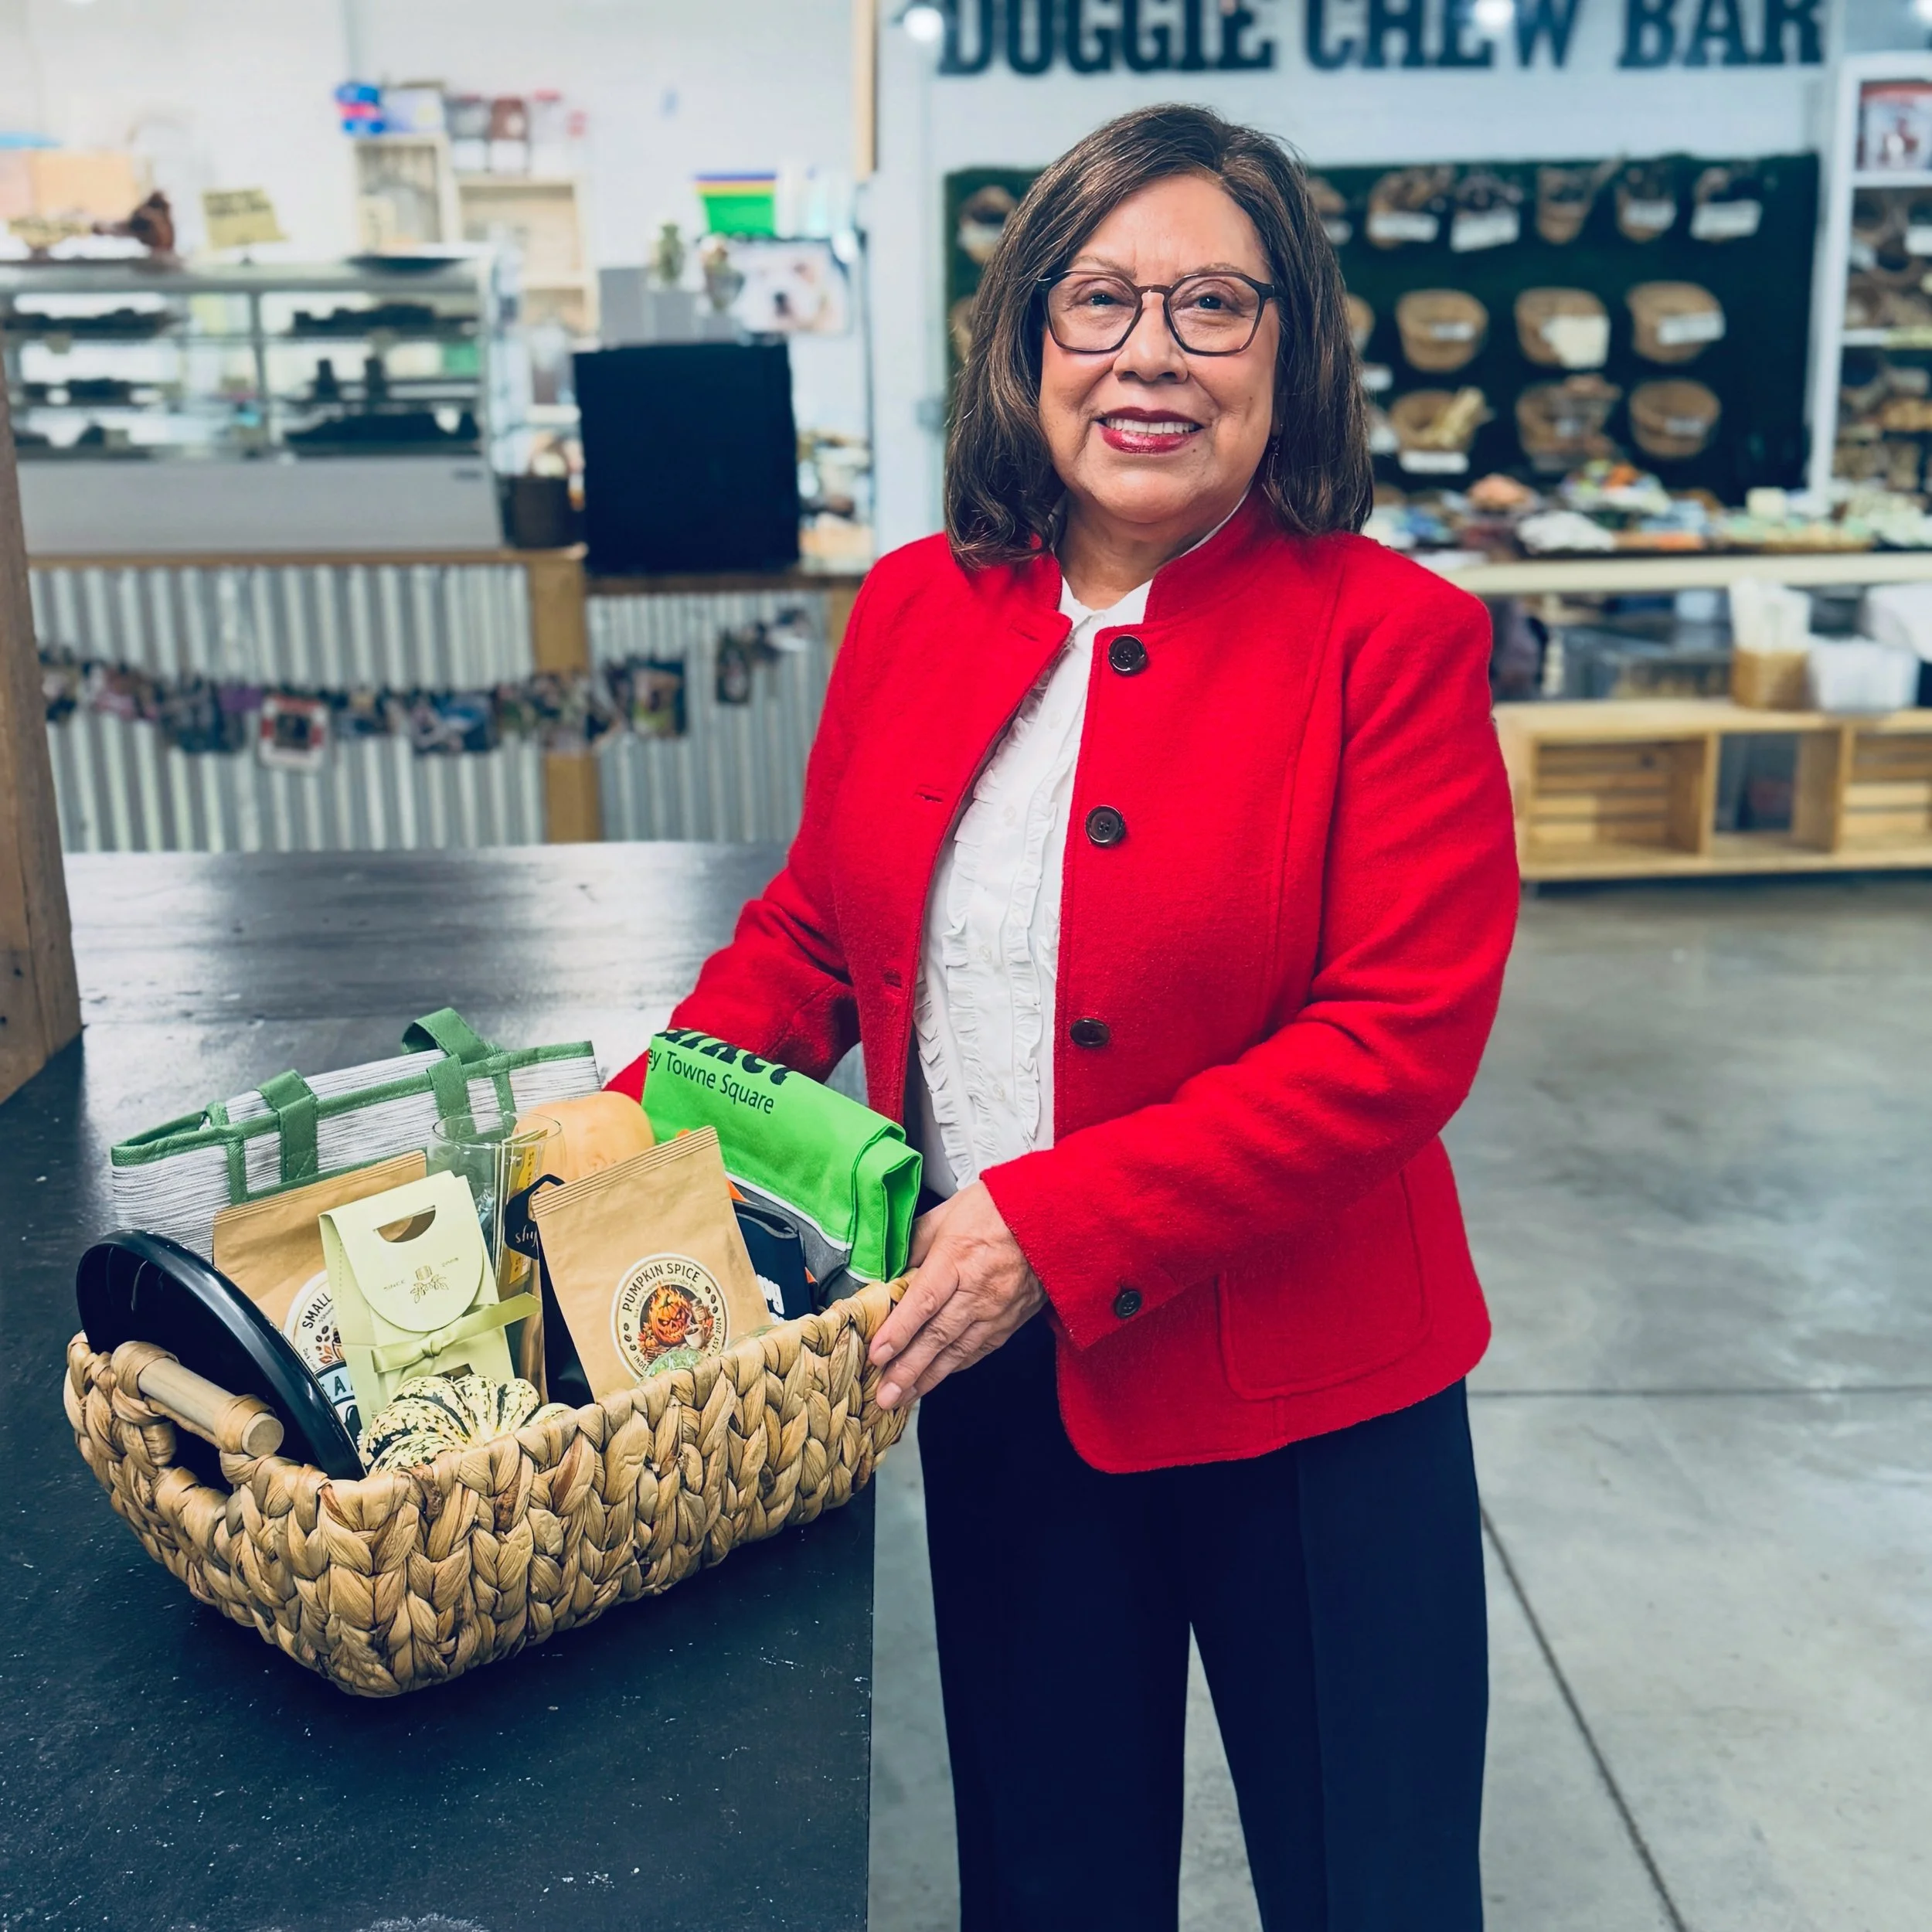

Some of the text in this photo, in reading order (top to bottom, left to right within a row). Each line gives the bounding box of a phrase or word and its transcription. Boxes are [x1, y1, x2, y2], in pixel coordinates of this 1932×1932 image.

[938, 0, 1824, 75] DOGGIE CHEW BAR
[667, 1051, 716, 1090] Towne
[719, 1073, 774, 1114] Square
[302, 1293, 333, 1328] SMALL
[622, 1264, 664, 1312] PUMPKIN
[667, 1263, 700, 1283] SPICE
